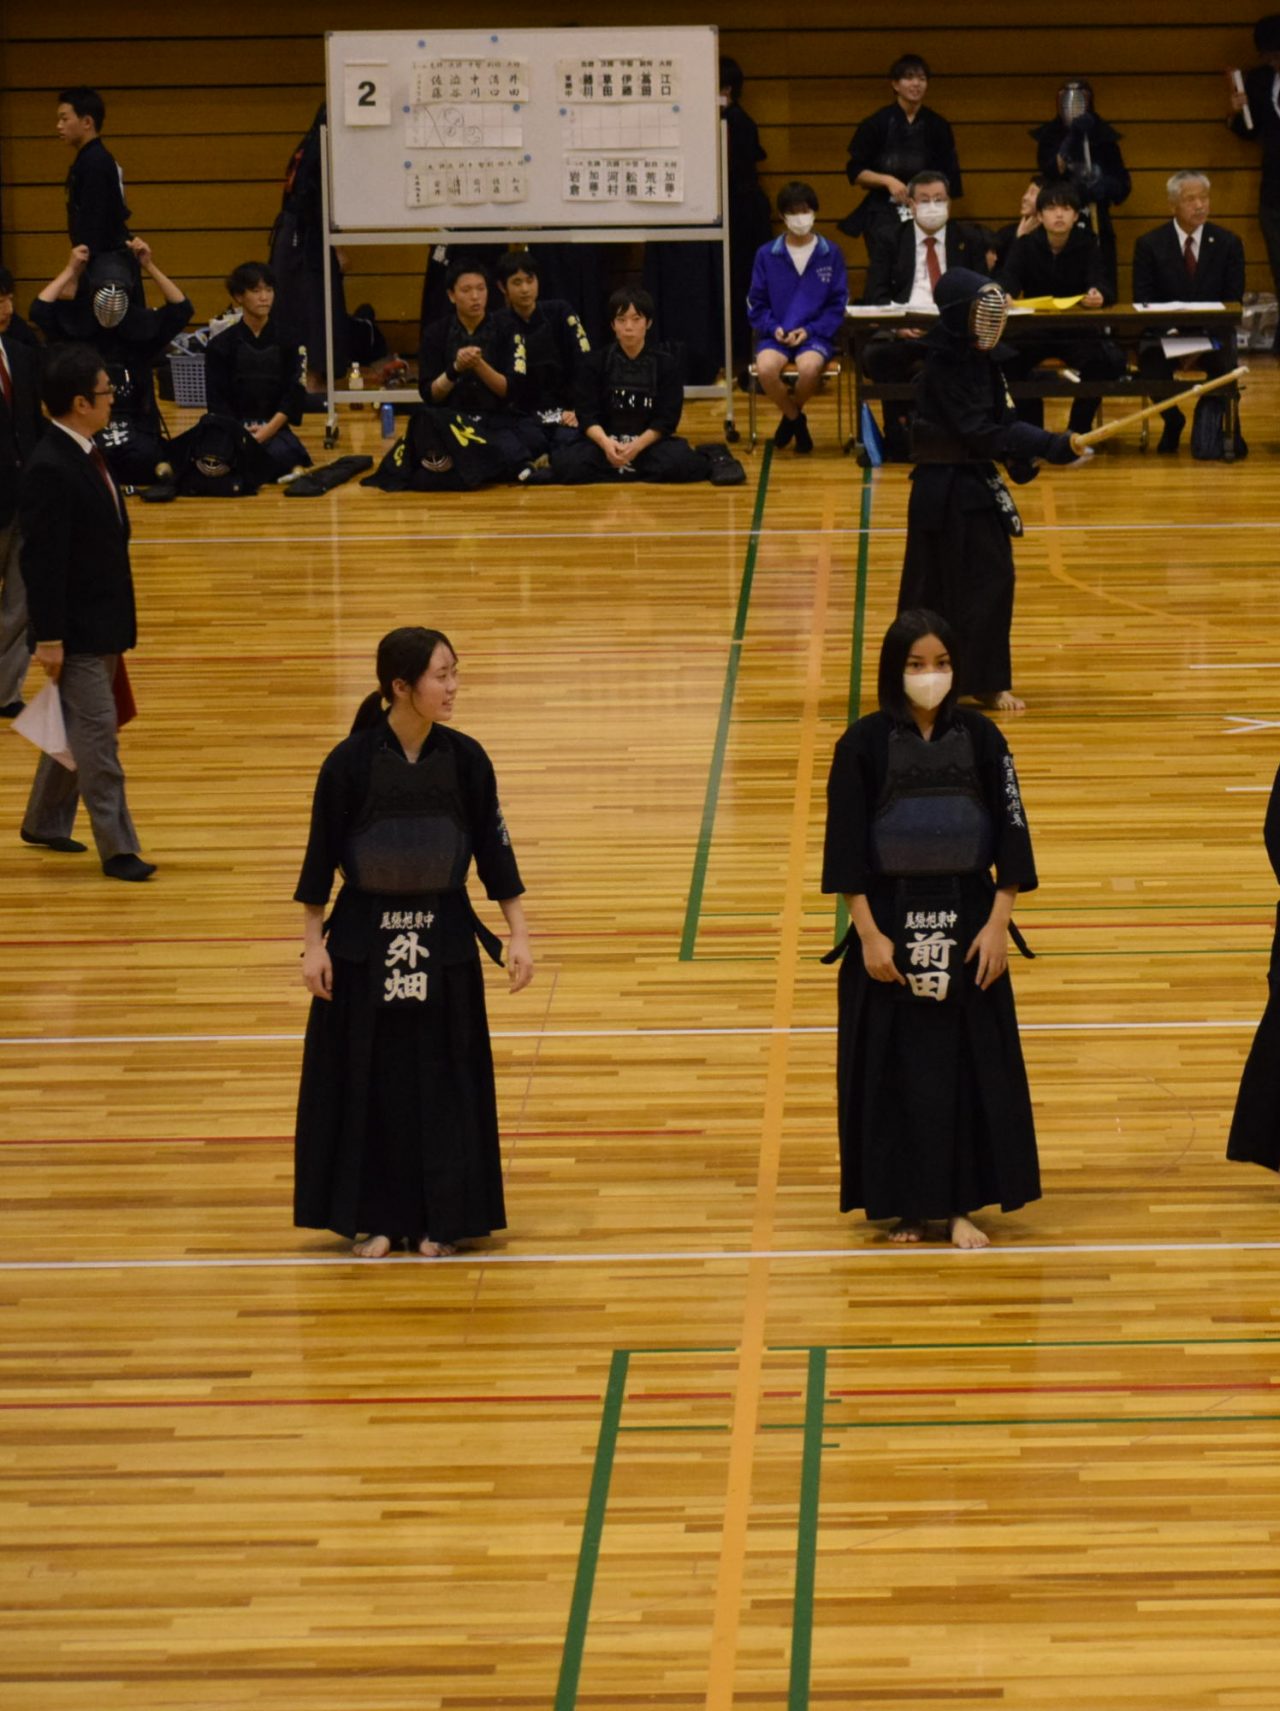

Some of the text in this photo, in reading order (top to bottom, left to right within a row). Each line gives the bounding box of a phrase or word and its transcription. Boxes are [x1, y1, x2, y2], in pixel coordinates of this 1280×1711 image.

[358, 81, 376, 107] 2
[661, 74, 672, 96] 江口
[380, 911, 435, 929] 尾張旭東中
[904, 910, 958, 929] 尾張旭東中
[384, 932, 430, 1001] 外畑
[905, 931, 957, 1001] 前田
